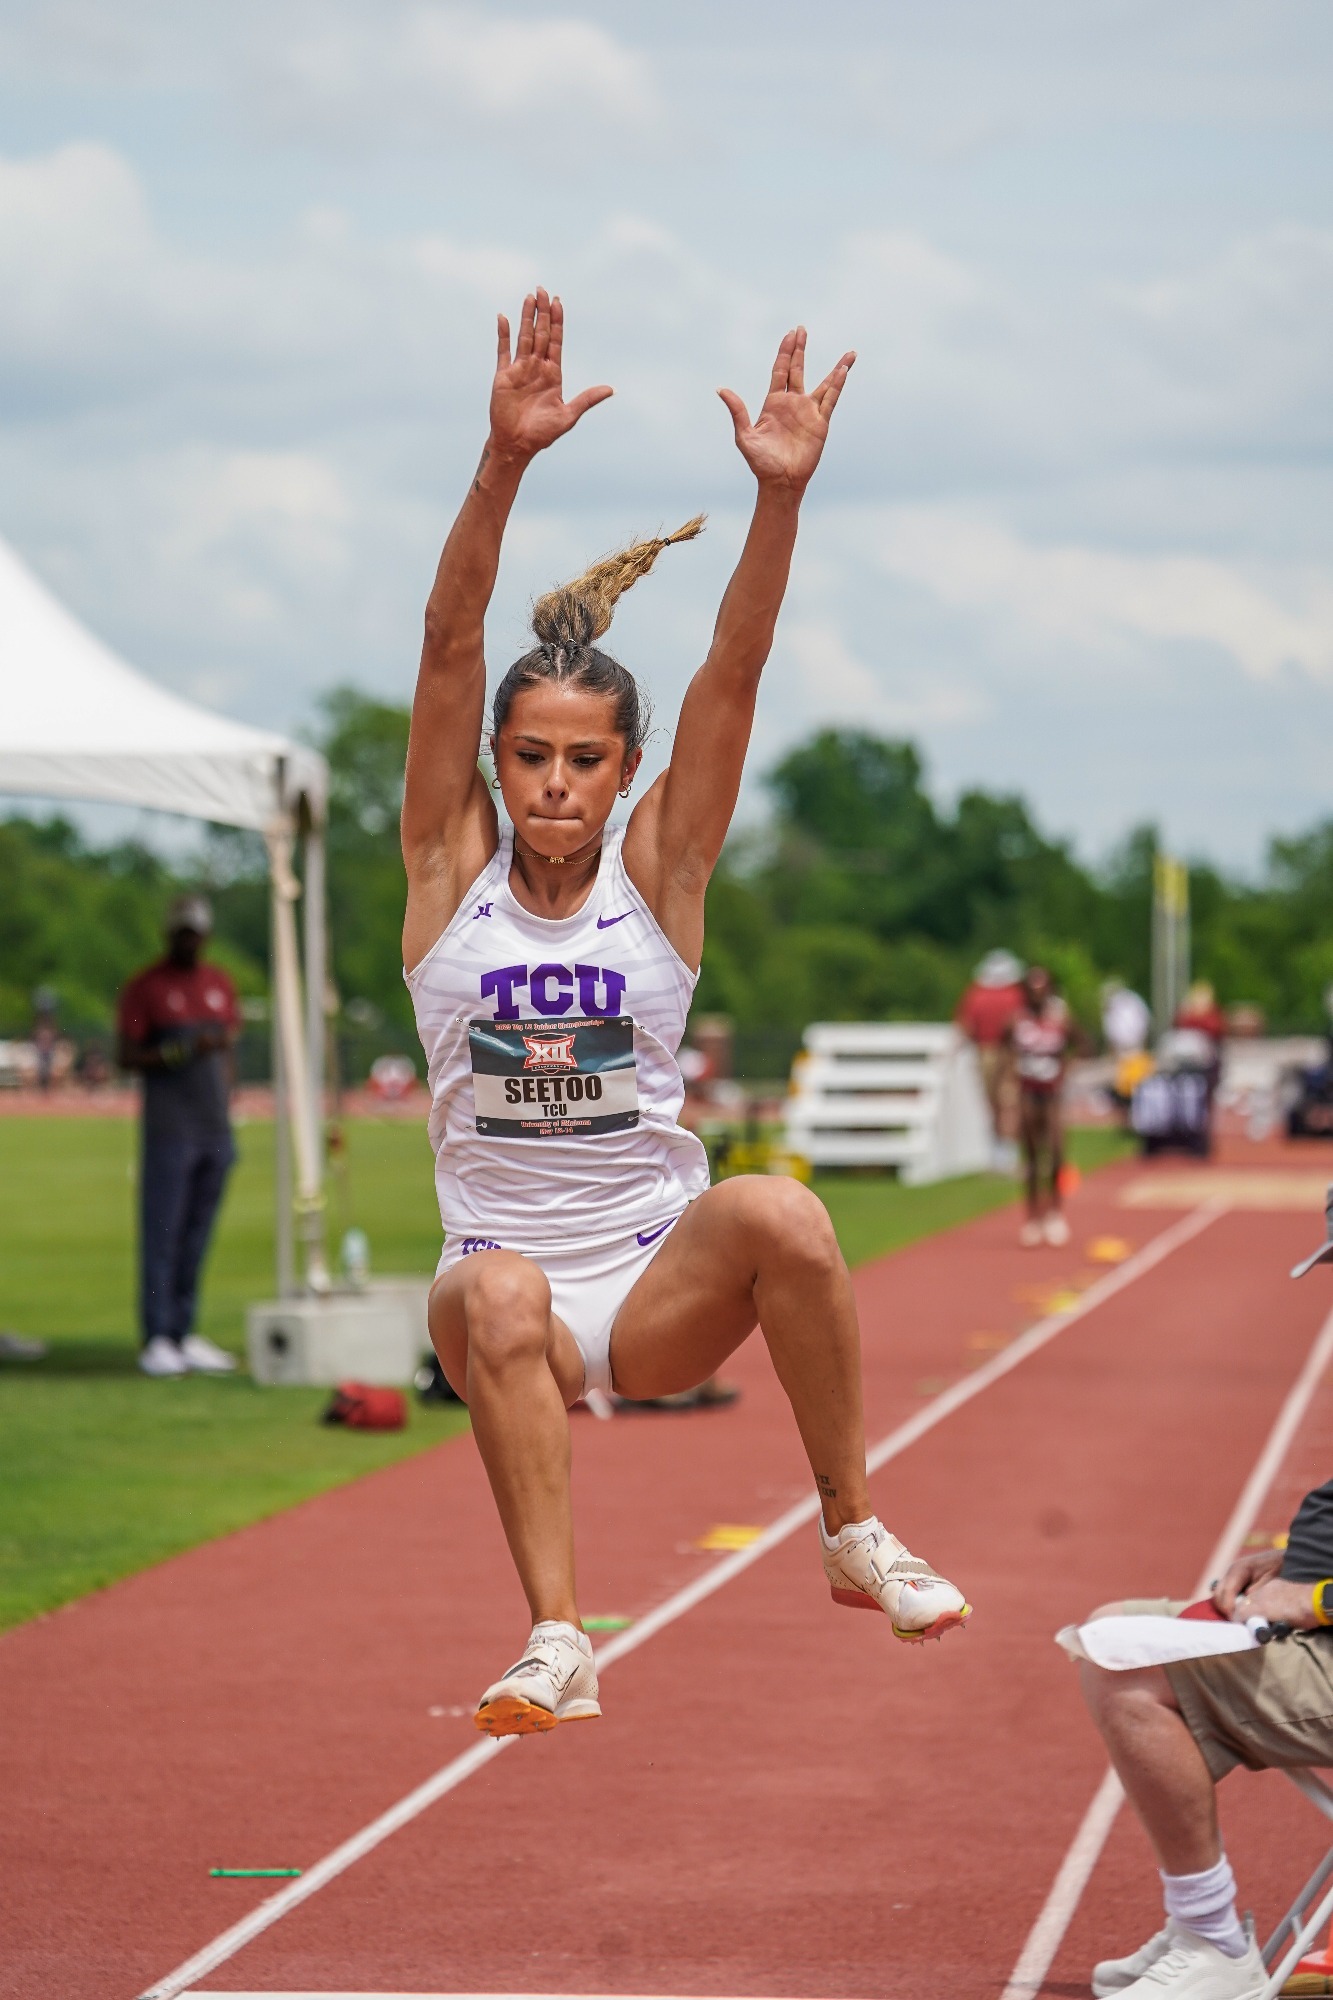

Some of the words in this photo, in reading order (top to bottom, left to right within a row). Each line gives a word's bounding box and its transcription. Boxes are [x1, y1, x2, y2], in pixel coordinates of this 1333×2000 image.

[480, 963, 627, 1021] TCU
[527, 1040, 573, 1066] XII
[504, 1075, 603, 1105] SEETOO
[541, 1103, 568, 1118] TCU
